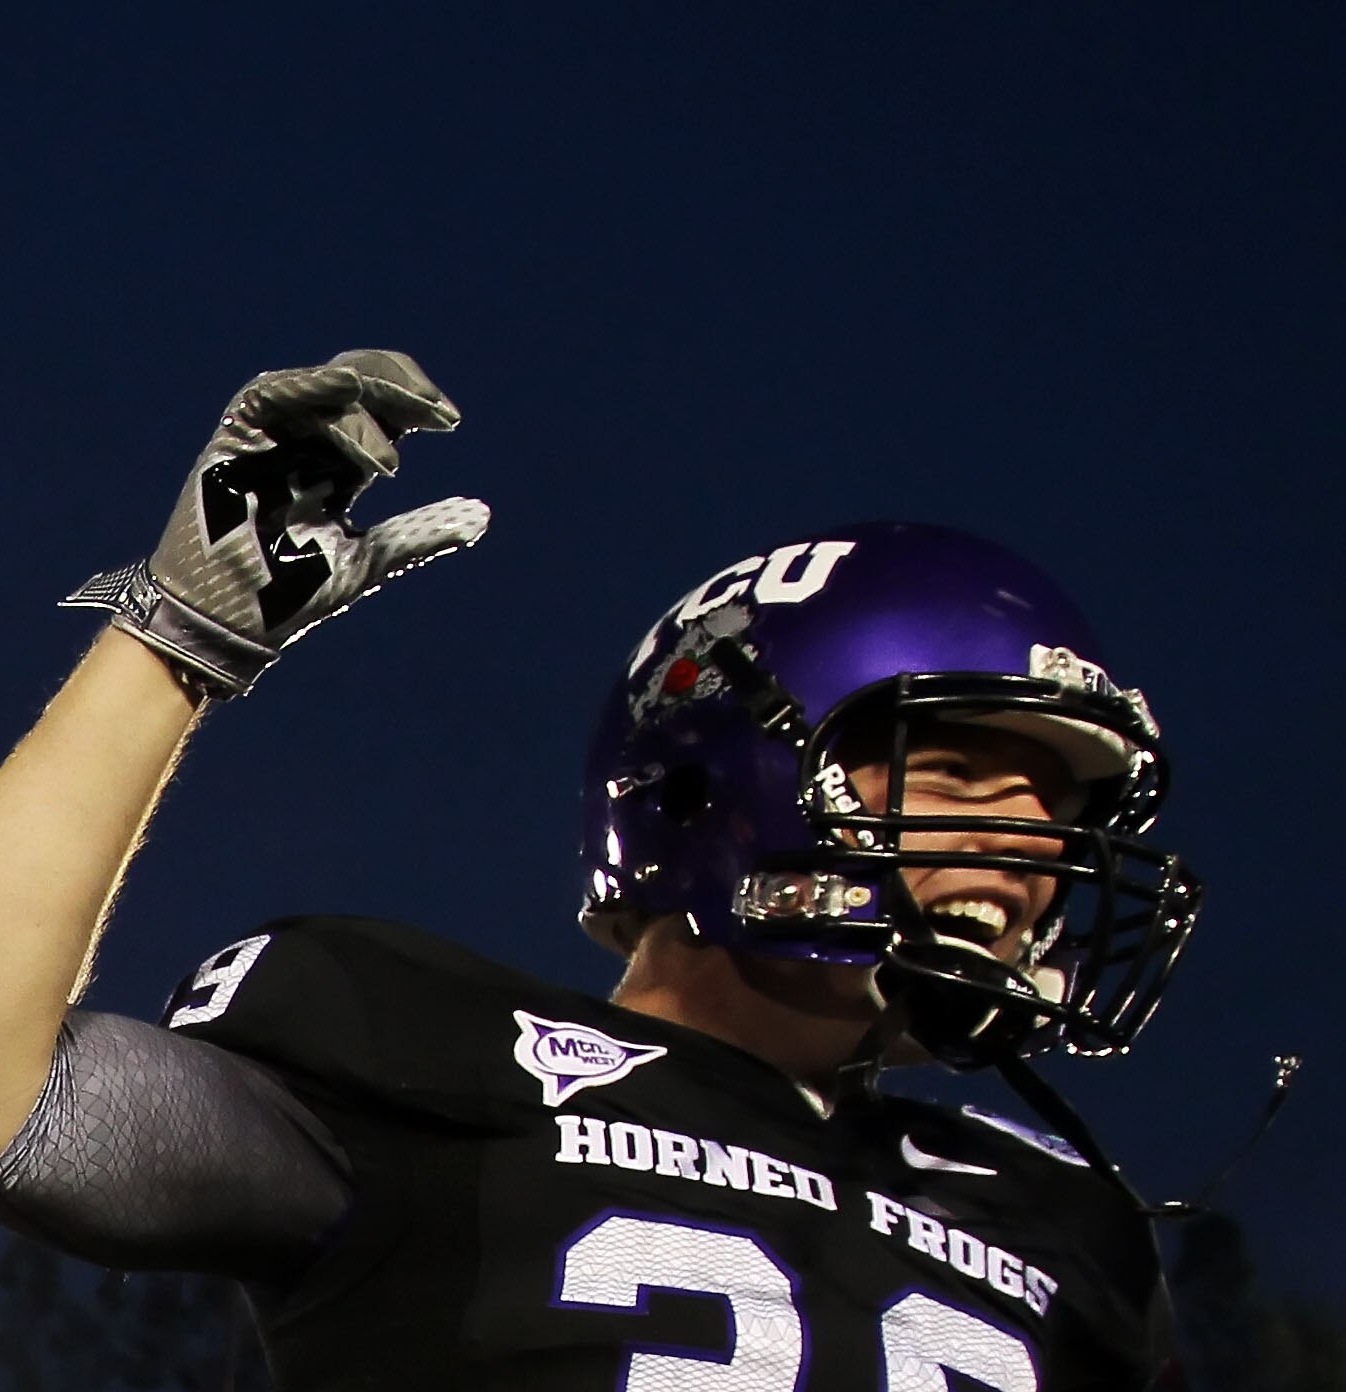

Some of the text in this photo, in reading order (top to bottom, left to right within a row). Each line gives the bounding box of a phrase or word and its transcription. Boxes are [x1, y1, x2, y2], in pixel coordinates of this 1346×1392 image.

[579, 1053, 617, 1067] WEST
[554, 1115, 1059, 1317] HORNED FROGS
